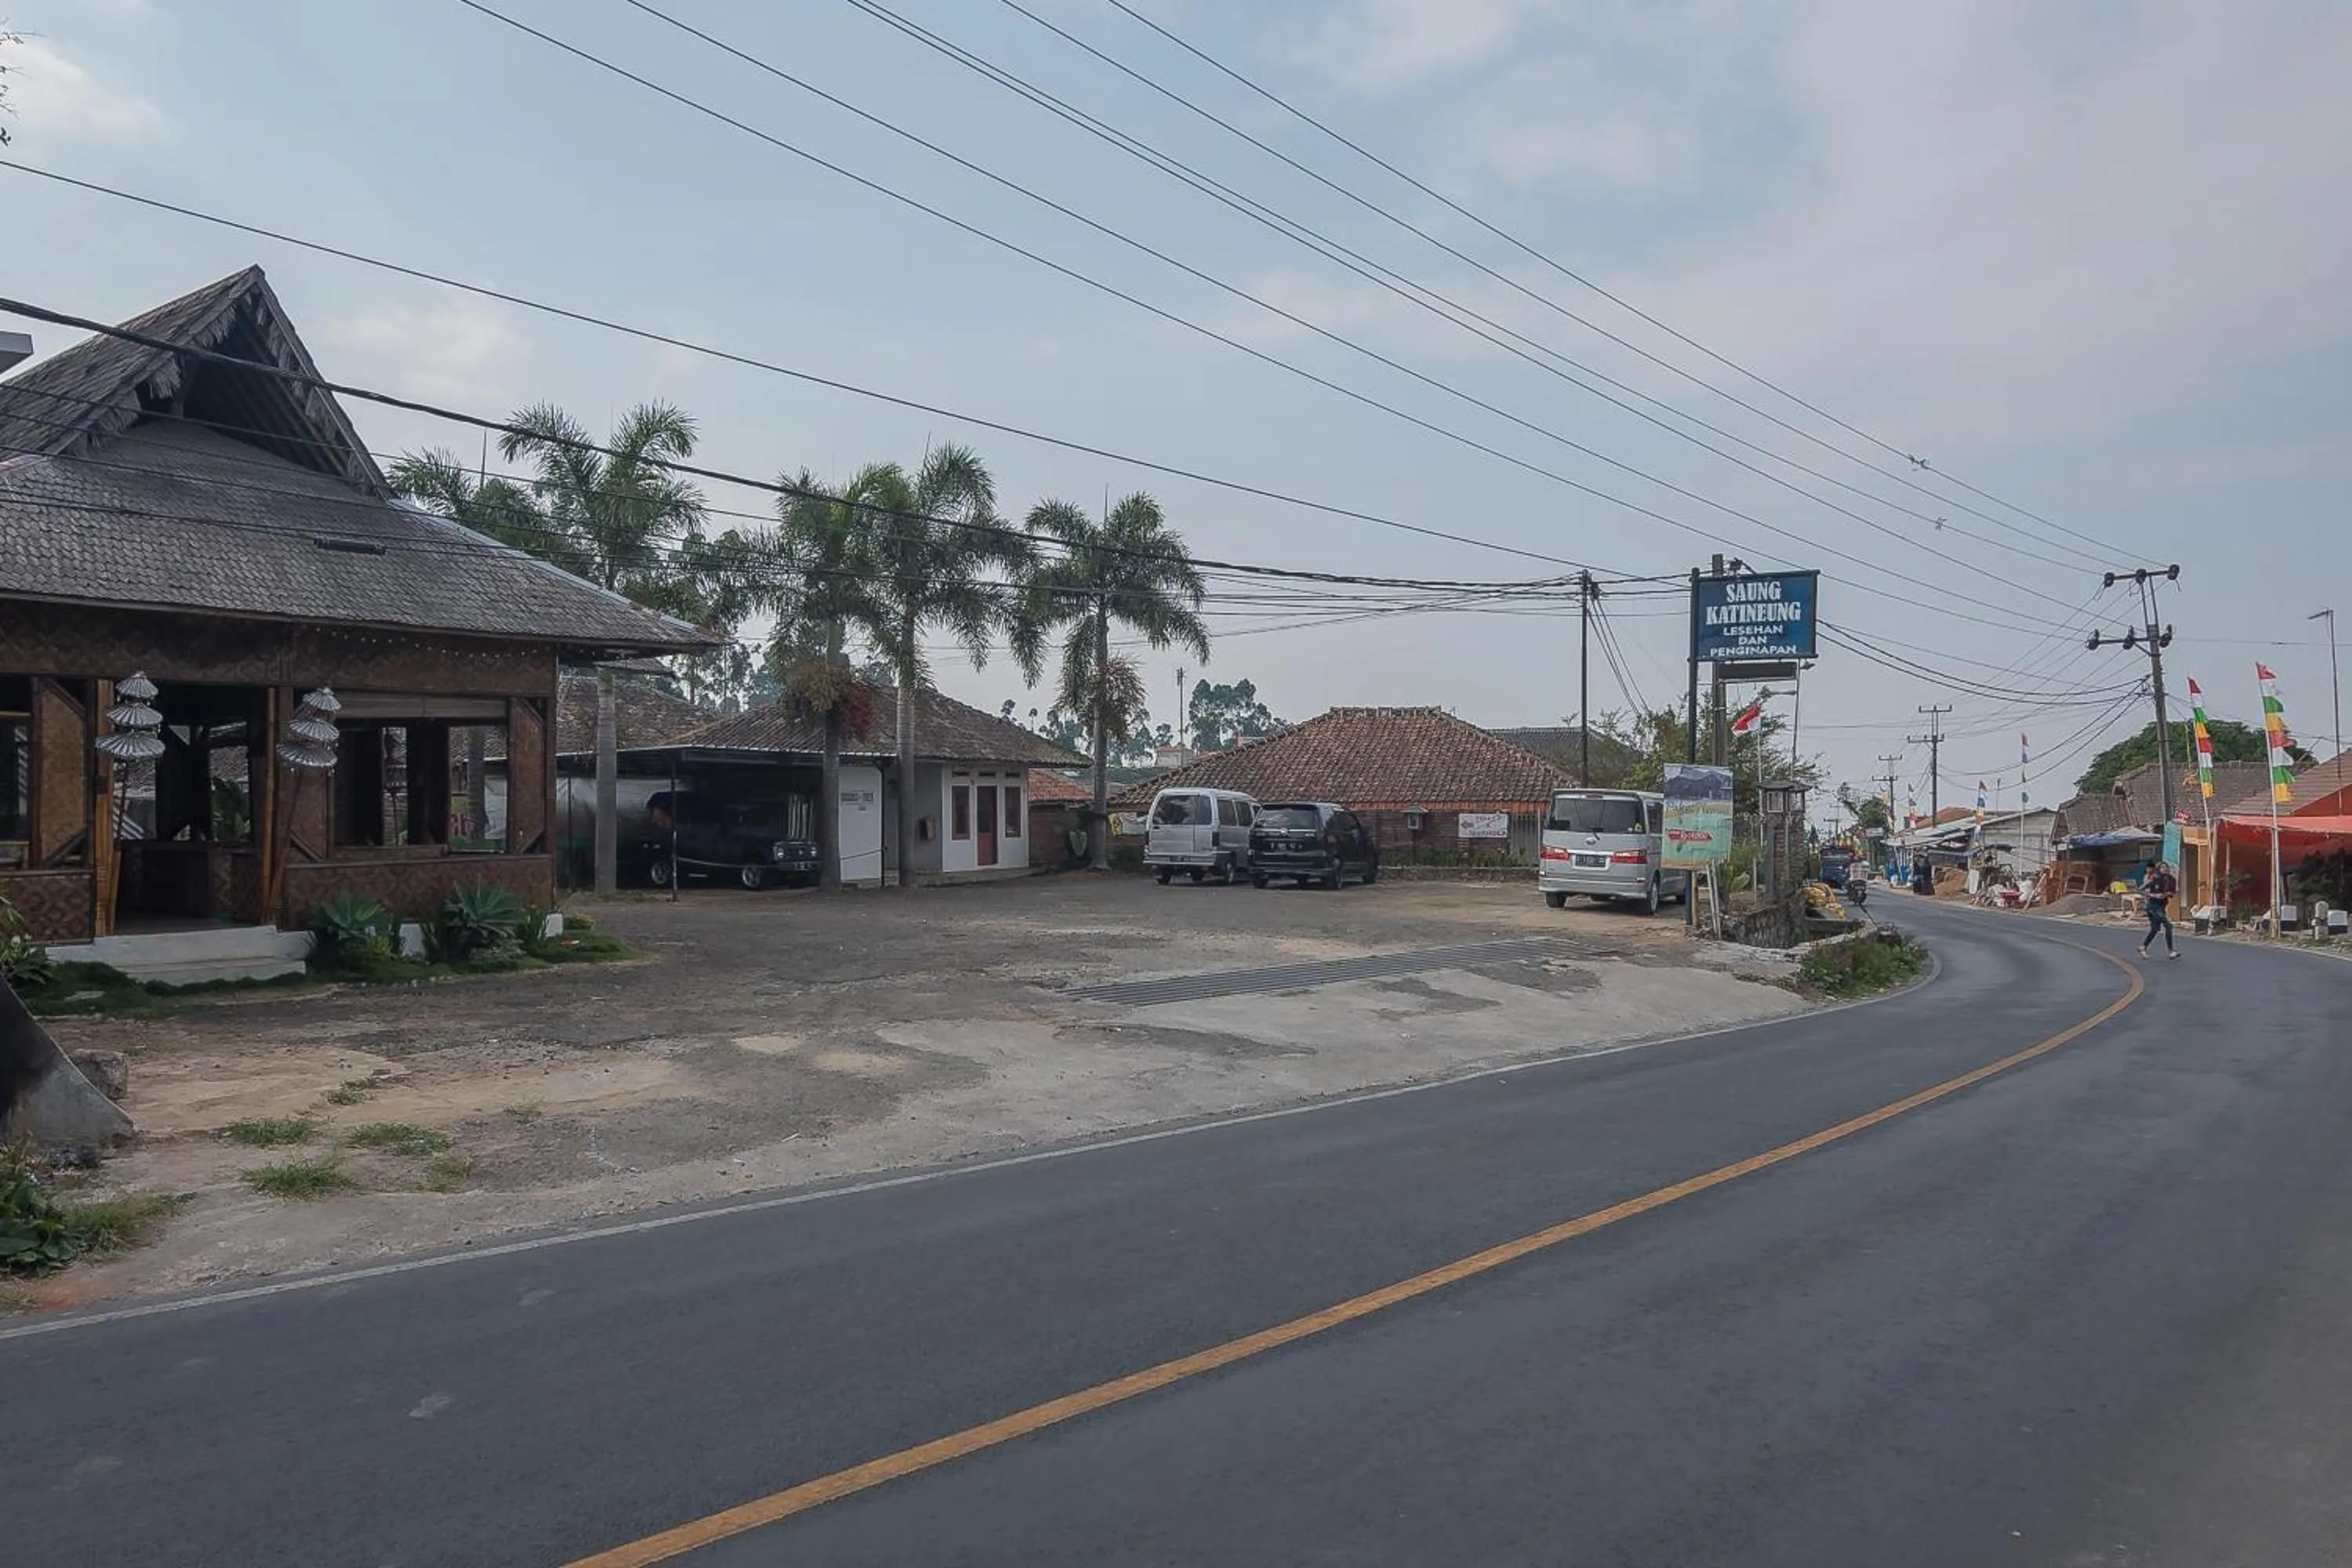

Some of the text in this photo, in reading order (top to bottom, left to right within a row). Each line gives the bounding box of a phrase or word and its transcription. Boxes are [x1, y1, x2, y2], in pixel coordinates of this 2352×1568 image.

[1726, 582, 1782, 601] SAUNG
[1706, 602, 1801, 624] KATINEUNG
[1723, 626, 1783, 635] LESEHAN
[1738, 636, 1767, 644] DAN
[1710, 645, 1796, 656] PENGINAPAN
